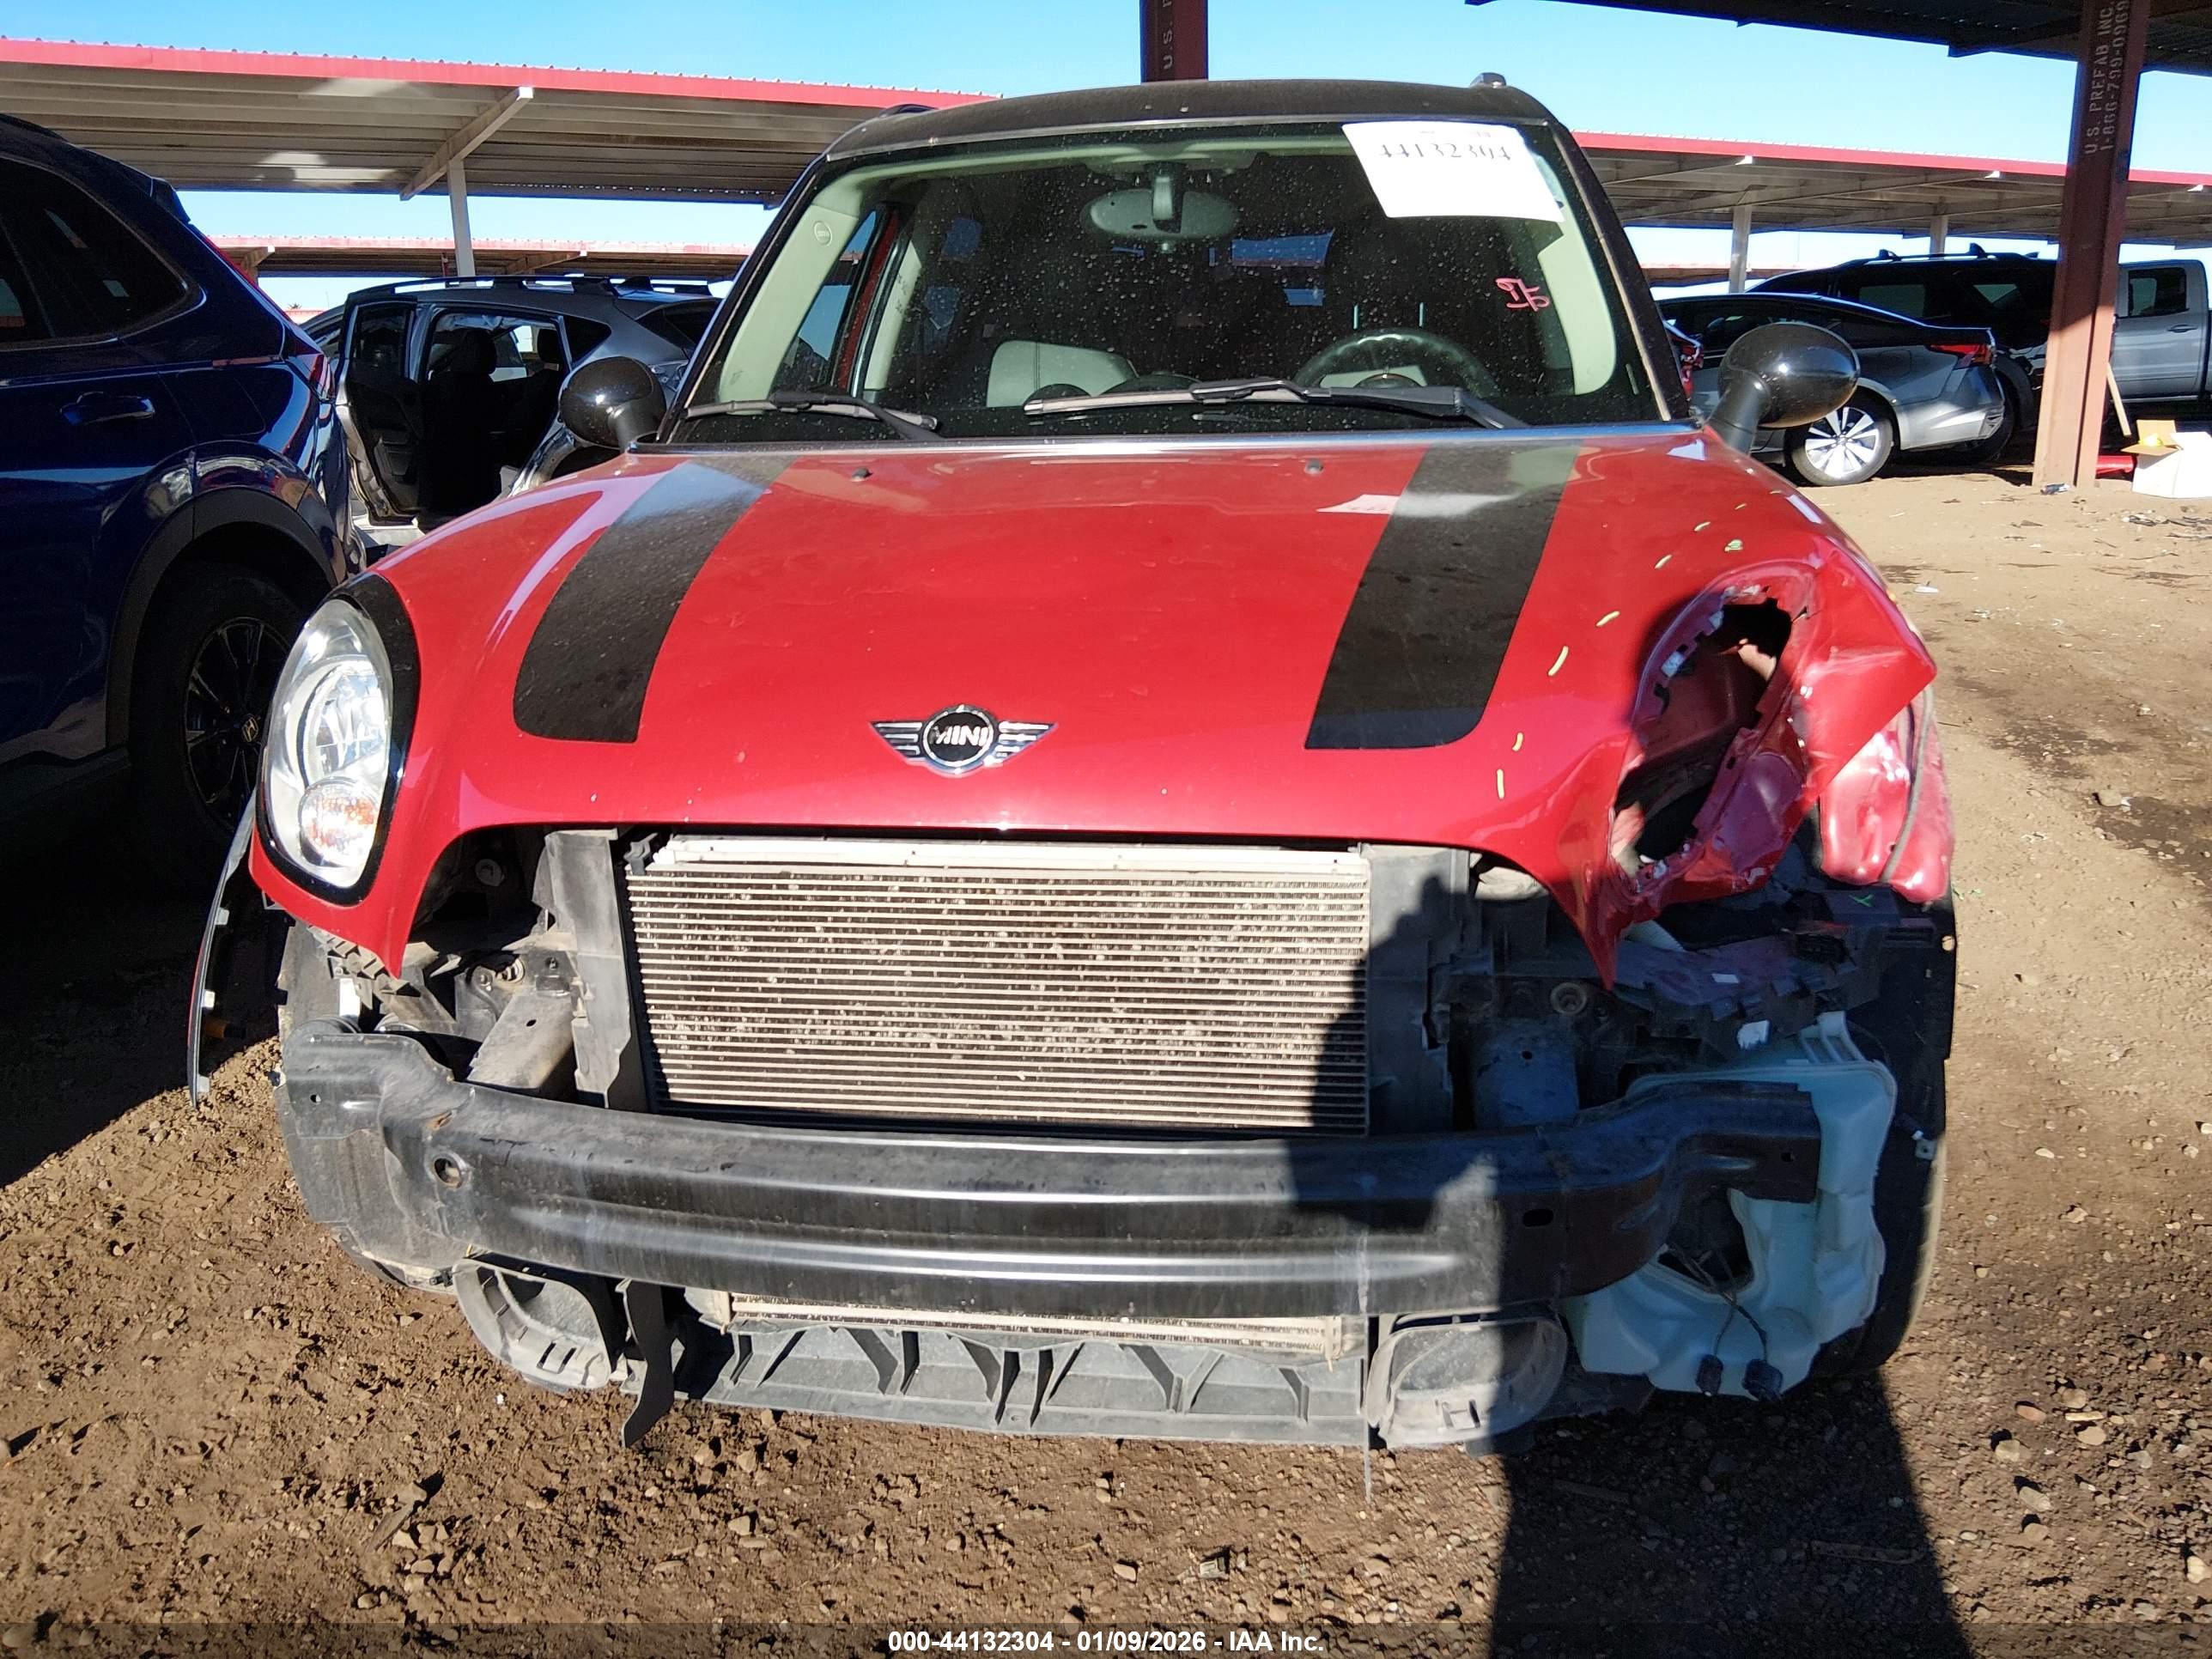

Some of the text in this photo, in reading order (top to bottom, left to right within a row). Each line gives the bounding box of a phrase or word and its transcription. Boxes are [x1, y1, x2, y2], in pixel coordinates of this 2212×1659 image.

[1162, 21, 1173, 70] U.S.
[2084, 1, 2114, 155] U.S. PREFAB INC.
[1379, 143, 1511, 161] 44132304
[928, 725, 988, 747] MINI
